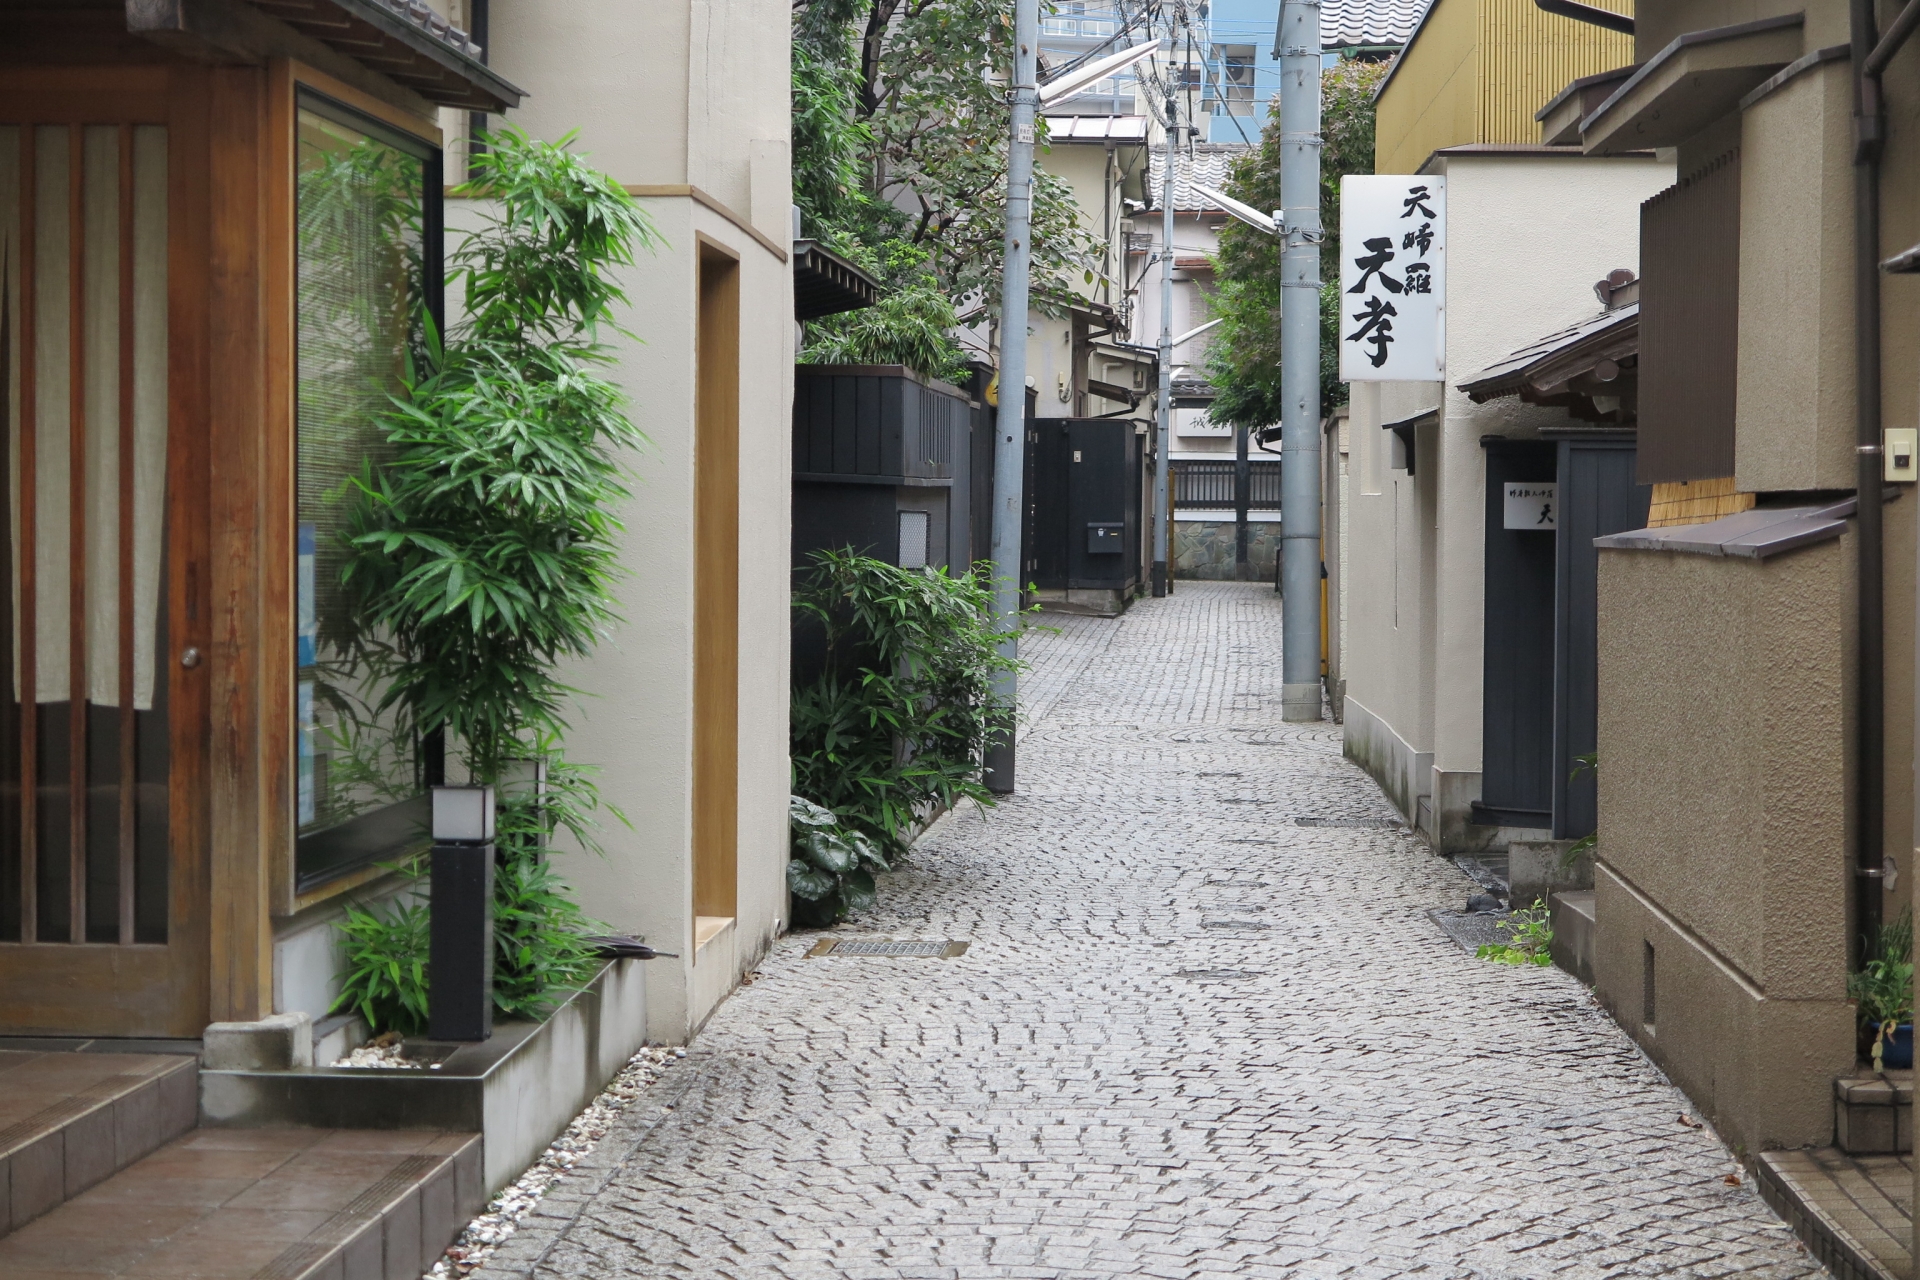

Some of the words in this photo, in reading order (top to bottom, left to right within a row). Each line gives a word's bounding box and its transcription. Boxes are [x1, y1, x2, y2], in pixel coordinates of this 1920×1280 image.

[1400, 185, 1437, 296] 天婦羅
[1344, 237, 1404, 368] 天孝
